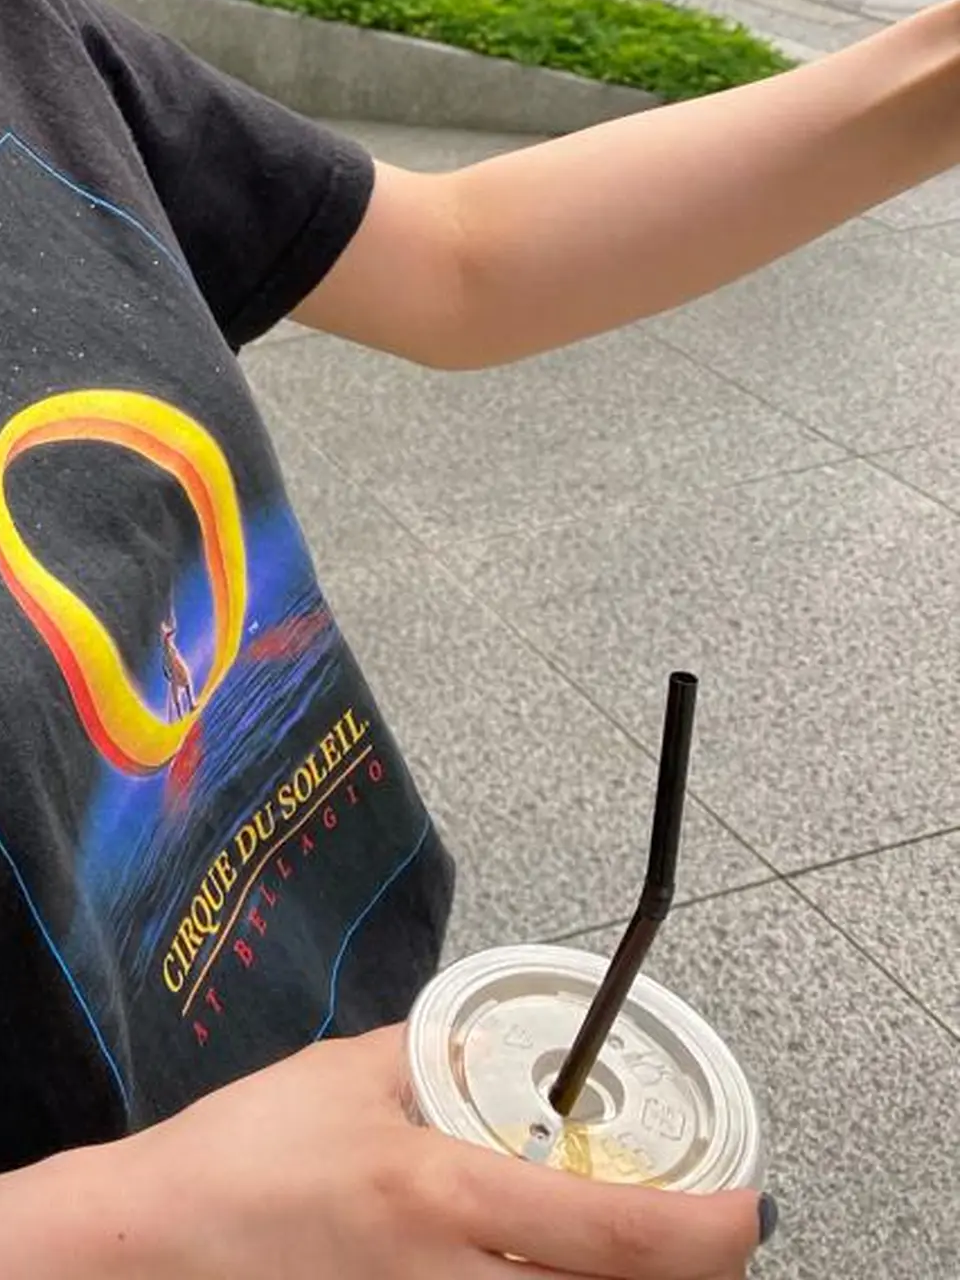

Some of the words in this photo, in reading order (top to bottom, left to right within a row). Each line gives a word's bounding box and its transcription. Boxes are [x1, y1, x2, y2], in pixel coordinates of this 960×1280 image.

[162, 850, 239, 993] CIRQUE
[235, 802, 278, 865] DU
[193, 987, 225, 1047] AT
[233, 758, 384, 968] BELLAGIO
